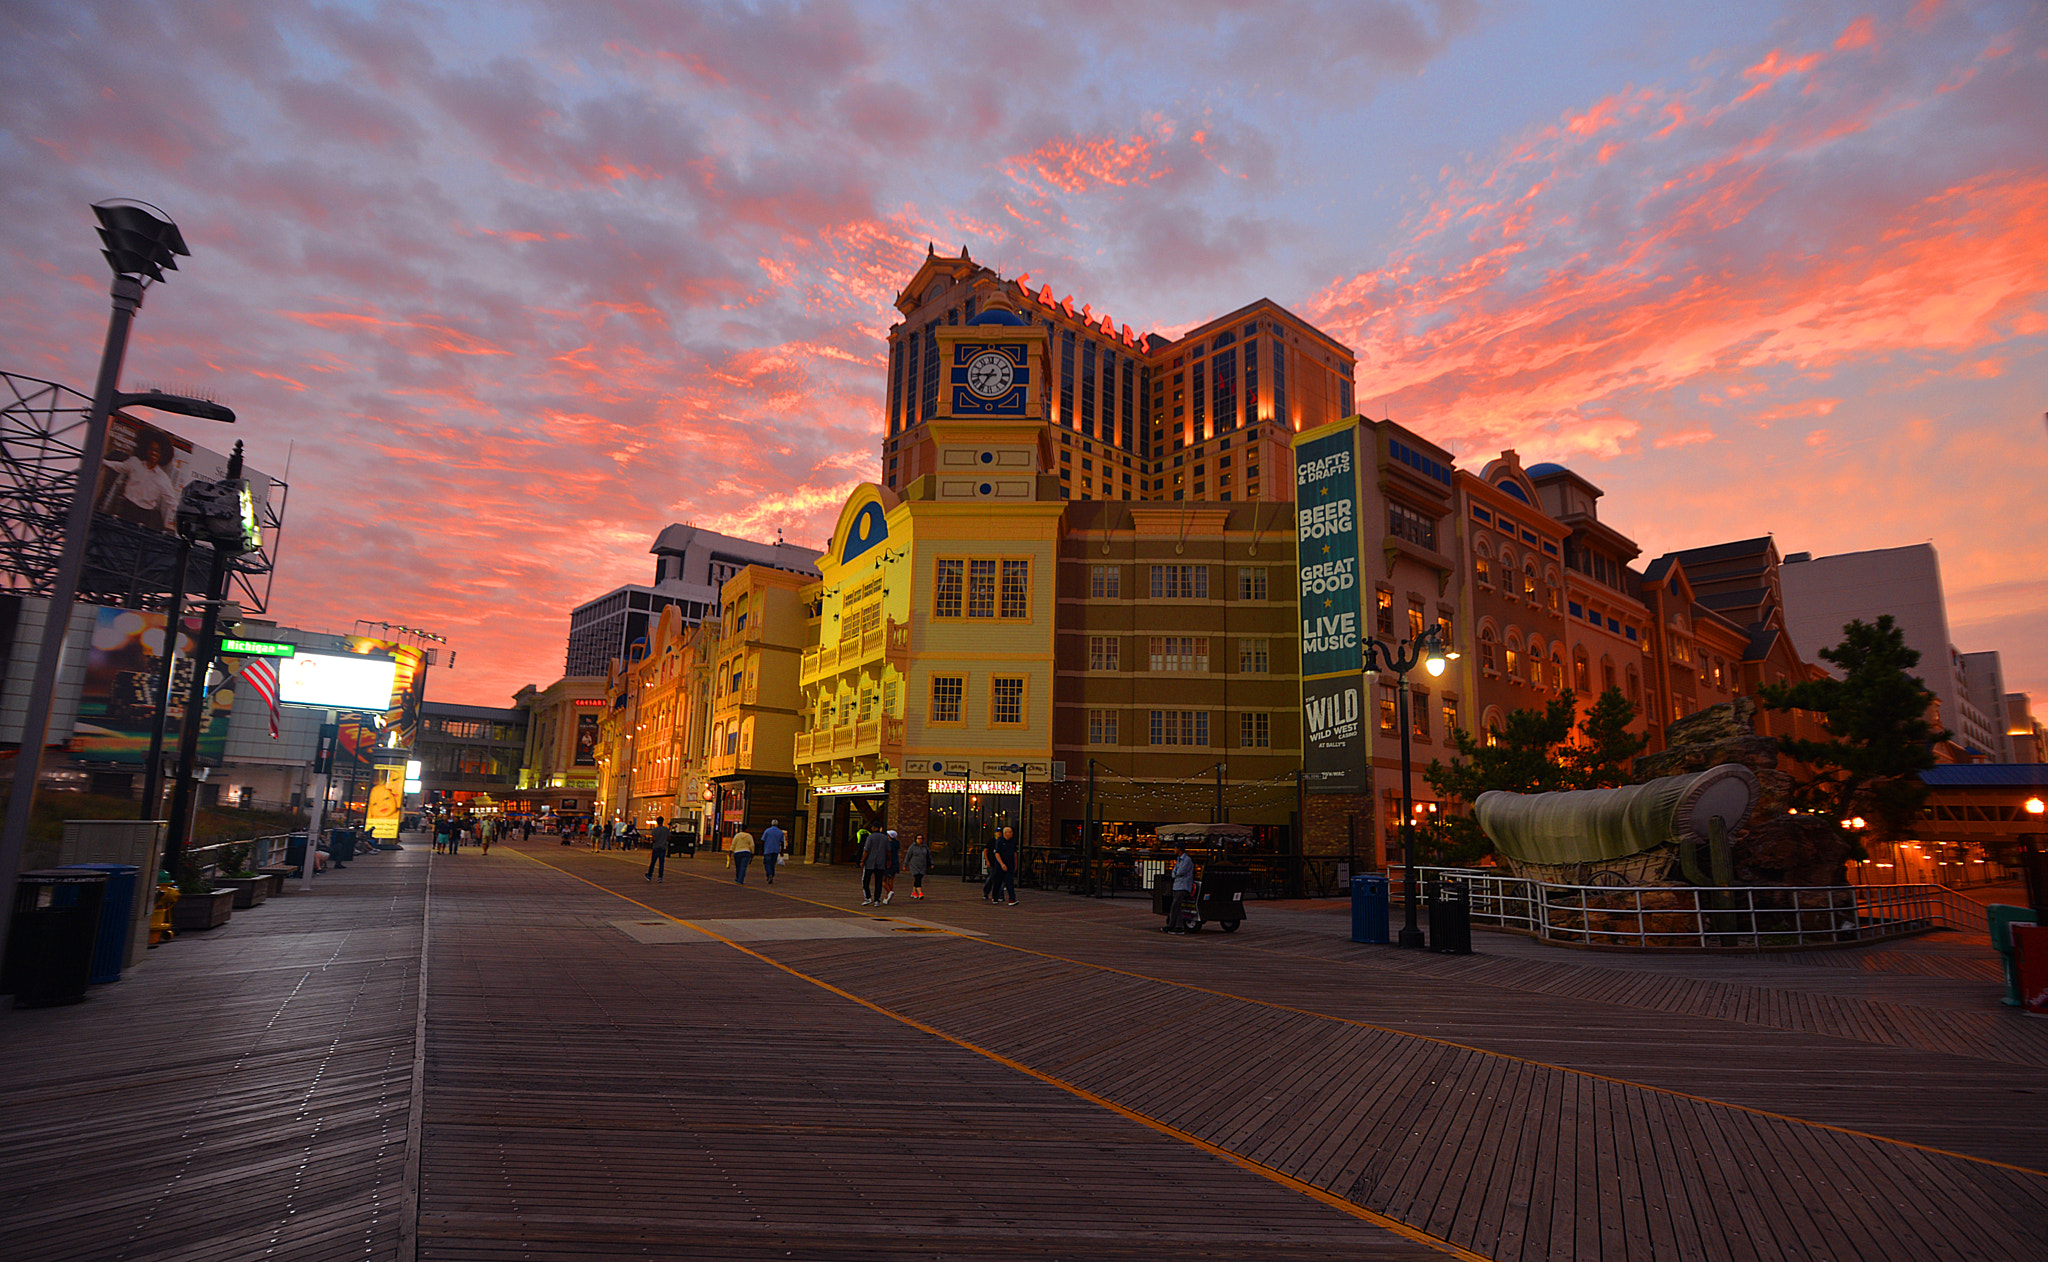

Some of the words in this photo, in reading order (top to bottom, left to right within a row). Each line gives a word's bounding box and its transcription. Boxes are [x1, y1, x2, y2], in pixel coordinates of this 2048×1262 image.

[1016, 272, 1150, 354] CAESARS
[1298, 451, 1350, 476] CRAFTS
[1298, 475, 1306, 485] &
[1308, 462, 1350, 483] DRAFTS
[1300, 499, 1352, 527] BEER
[1300, 516, 1352, 542] PONG
[1301, 557, 1355, 581] GREAT
[1302, 573, 1354, 597] FOOD
[1303, 612, 1355, 639] LIVE
[227, 640, 275, 654] Michigan
[1303, 633, 1357, 654] MUSIC
[1305, 688, 1358, 733] WILD
[1310, 730, 1331, 742] WILD
[1333, 722, 1358, 735] WEST
[1338, 731, 1358, 740] CASINO
